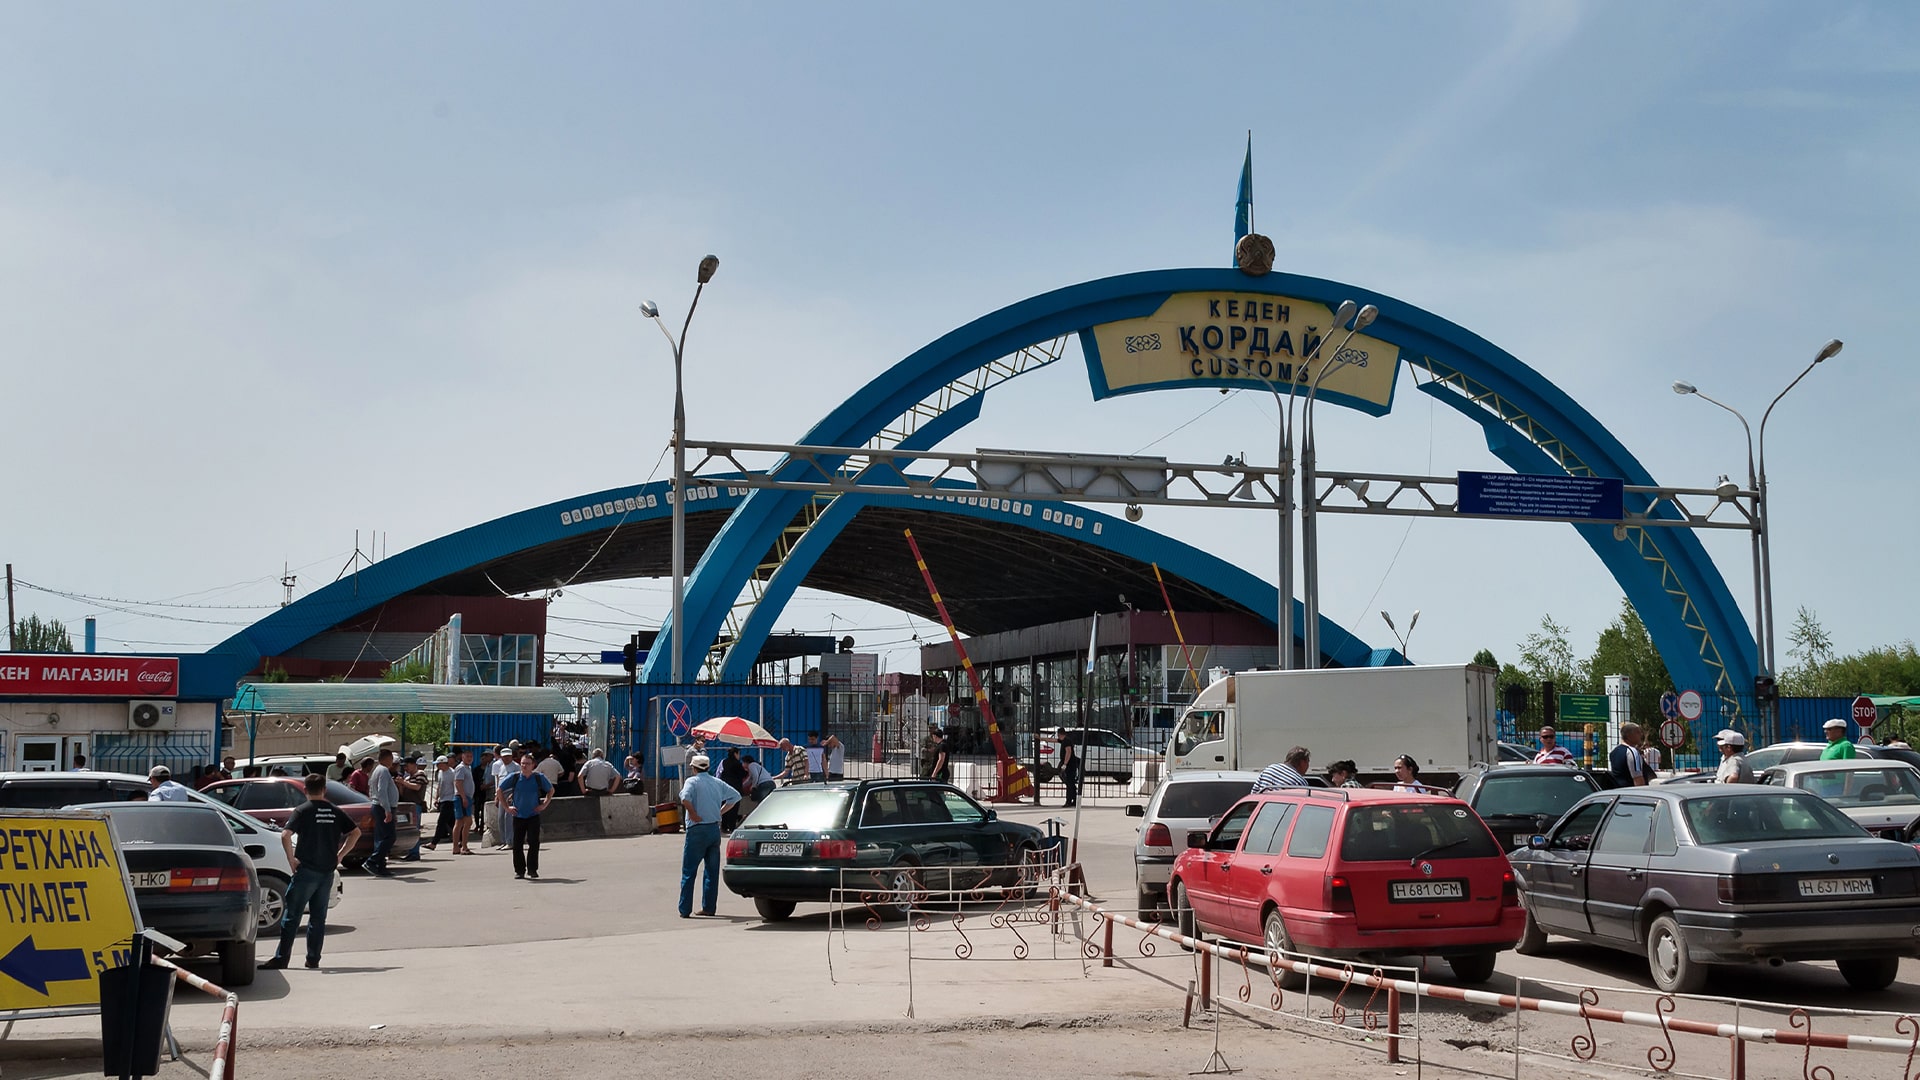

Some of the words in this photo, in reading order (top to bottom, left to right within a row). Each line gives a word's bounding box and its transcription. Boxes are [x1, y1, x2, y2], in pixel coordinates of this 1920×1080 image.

[1208, 299, 1290, 322] КЕДЕН
[1179, 325, 1321, 359] ҚОРДАЙ
[1191, 357, 1309, 382] CUSTOMS
[41, 667, 129, 682] МАГАЗИН
[1854, 706, 1875, 718] STOP
[0, 828, 111, 870] РЕТХАНА
[762, 844, 769, 853] H
[1395, 885, 1406, 897] H
[1409, 884, 1430, 896] 681
[1433, 883, 1460, 896] OFM
[1802, 882, 1813, 894] H
[1817, 881, 1838, 893] 637
[1842, 880, 1872, 893] MRM
[0, 881, 91, 924] ТУАЛЕТ
[92, 951, 108, 975] 5
